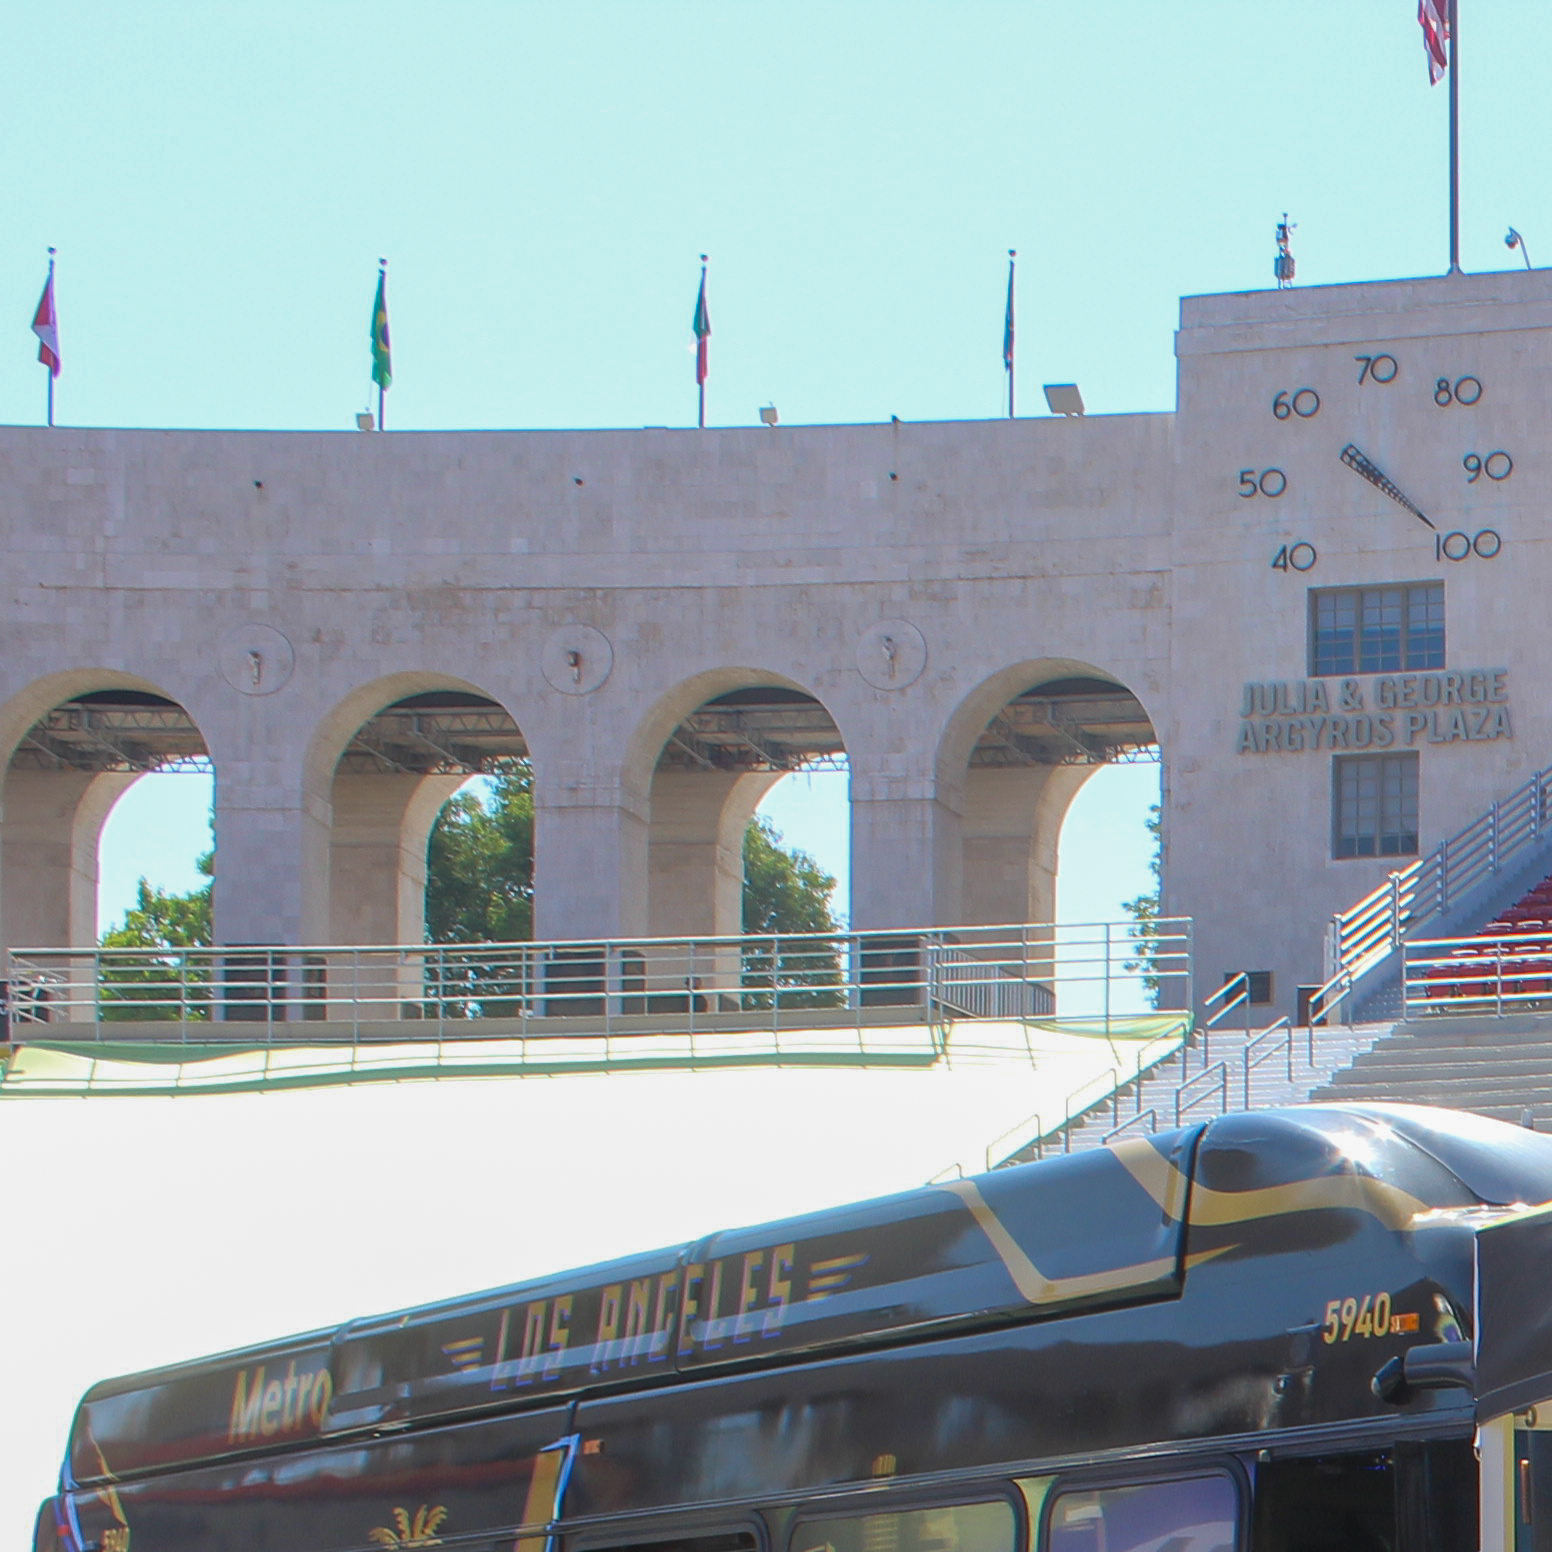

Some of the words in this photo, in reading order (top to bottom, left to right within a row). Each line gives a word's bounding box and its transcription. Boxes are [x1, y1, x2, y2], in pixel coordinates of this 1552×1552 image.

[1354, 354, 1398, 386] 70
[1272, 388, 1320, 420] 60
[1434, 376, 1482, 407] 80
[1238, 468, 1286, 498] 50
[1463, 451, 1513, 483] 90
[1271, 542, 1316, 572] 40
[1435, 529, 1501, 561] 100
[1239, 679, 1329, 718] JULIA
[1341, 677, 1364, 712] &
[1373, 667, 1509, 708] GEORGE
[1238, 713, 1395, 753] ARGYROS
[1404, 705, 1513, 745] PLAZA
[490, 1295, 572, 1391] LOS
[590, 1243, 795, 1375] ANGELES
[1322, 1292, 1391, 1344] 5940
[227, 1360, 333, 1444] Metro
